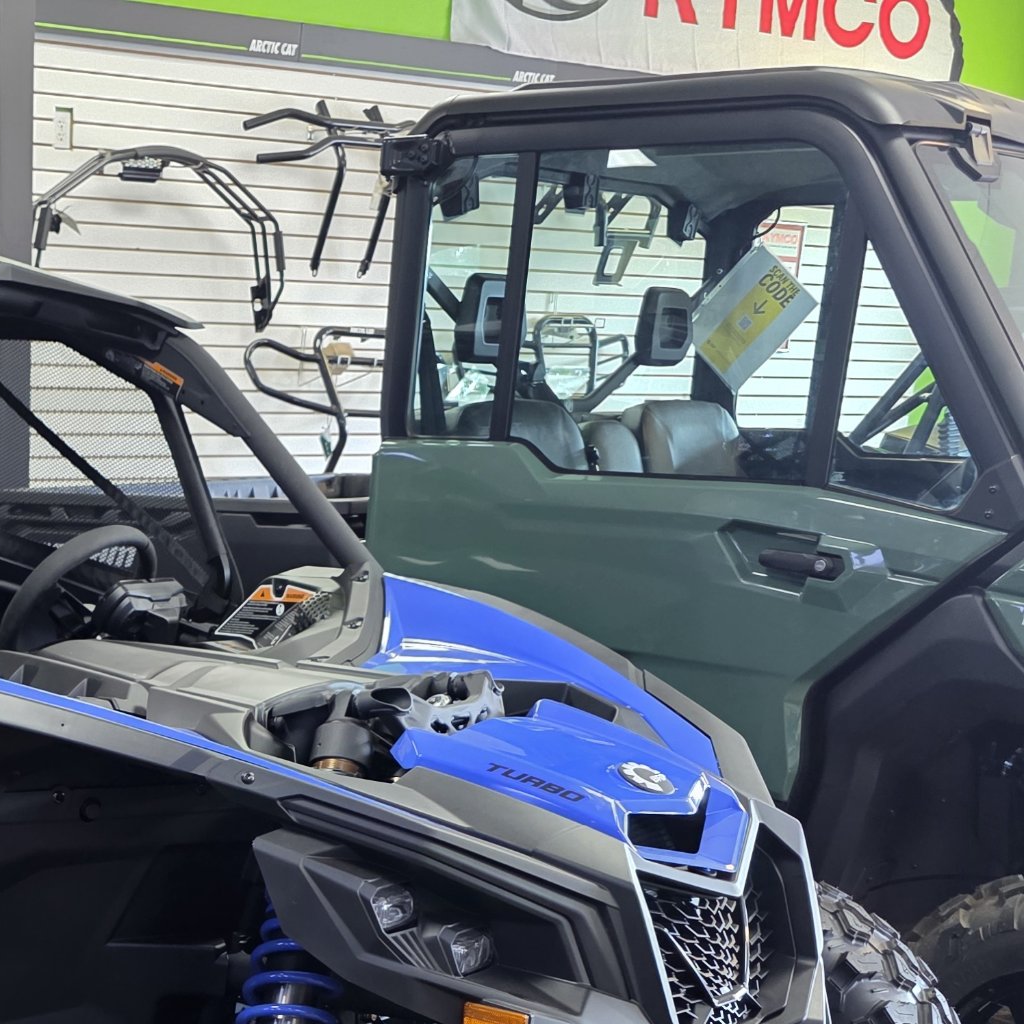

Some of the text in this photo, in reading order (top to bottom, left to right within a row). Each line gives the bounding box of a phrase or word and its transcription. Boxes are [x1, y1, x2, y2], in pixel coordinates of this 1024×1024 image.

[249, 39, 298, 56] ARCTIC CAT
[512, 71, 540, 83] ARCTIC
[758, 273, 795, 308] CODE
[486, 762, 585, 802] TURBO
